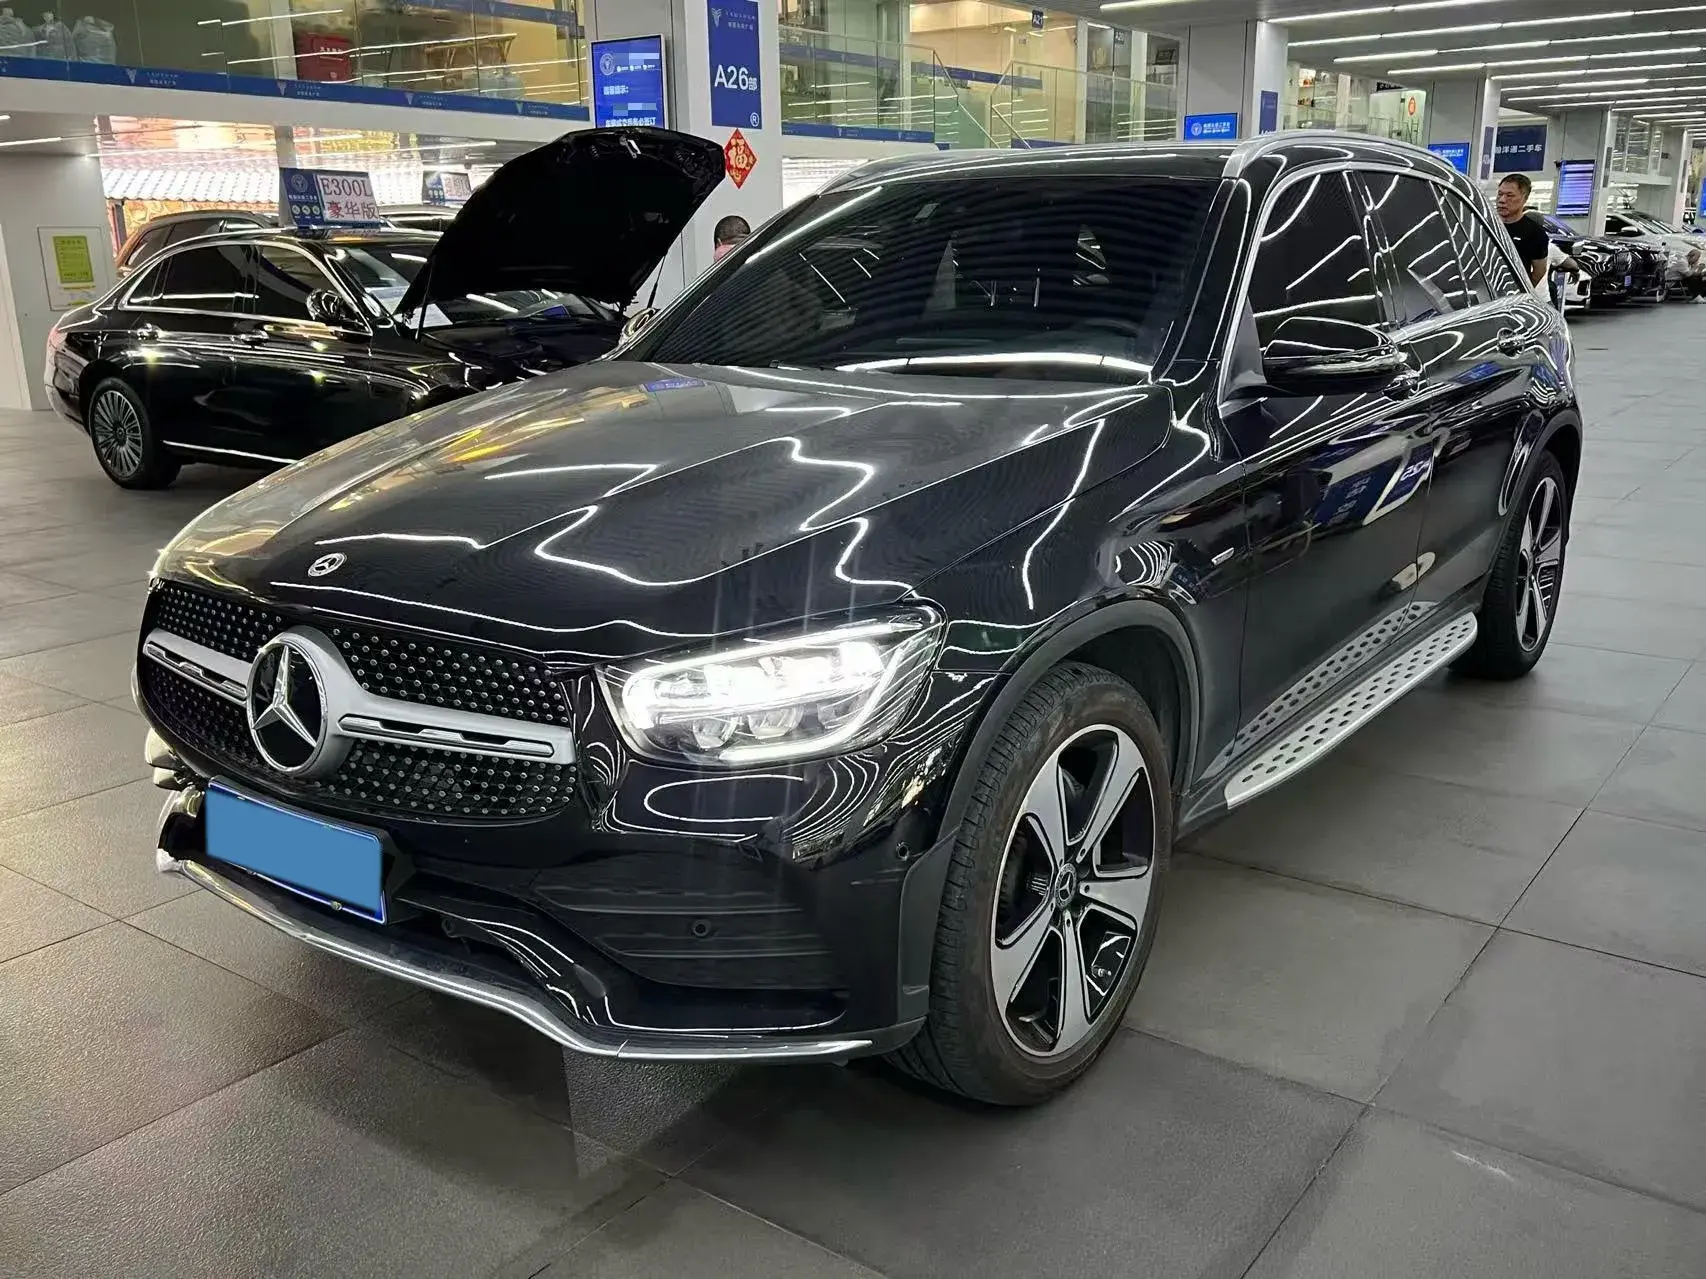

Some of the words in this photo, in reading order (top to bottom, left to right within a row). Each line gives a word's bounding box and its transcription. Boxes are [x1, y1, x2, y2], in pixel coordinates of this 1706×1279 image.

[321, 179, 373, 196] E300L
[326, 201, 378, 219] 豪华版
